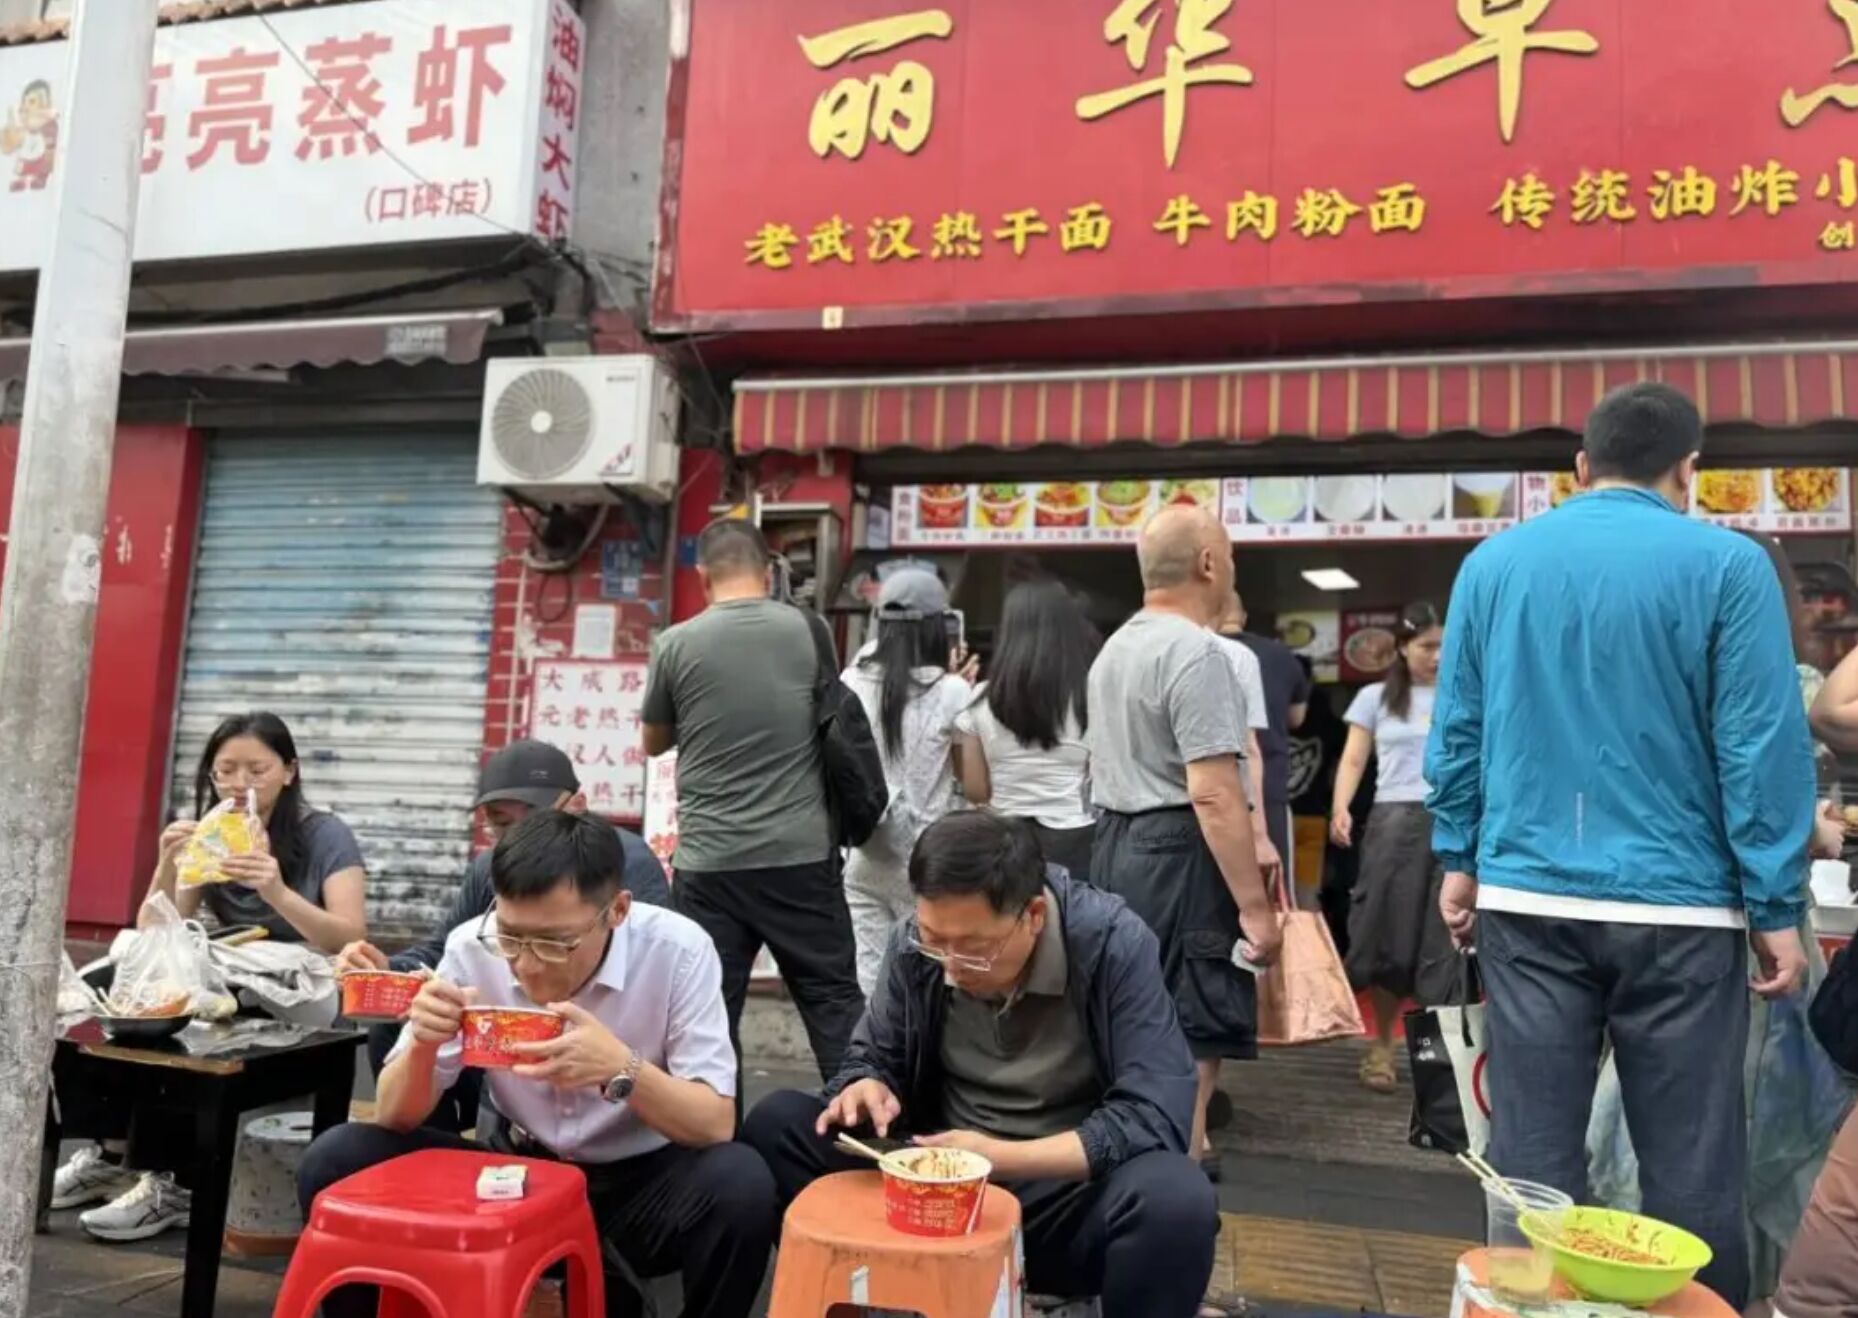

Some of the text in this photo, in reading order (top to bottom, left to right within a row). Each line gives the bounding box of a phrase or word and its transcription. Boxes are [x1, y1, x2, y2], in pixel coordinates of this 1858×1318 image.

[745, 156, 1858, 269] 老武汉热干面 牛肉粉面 传统油炸小
